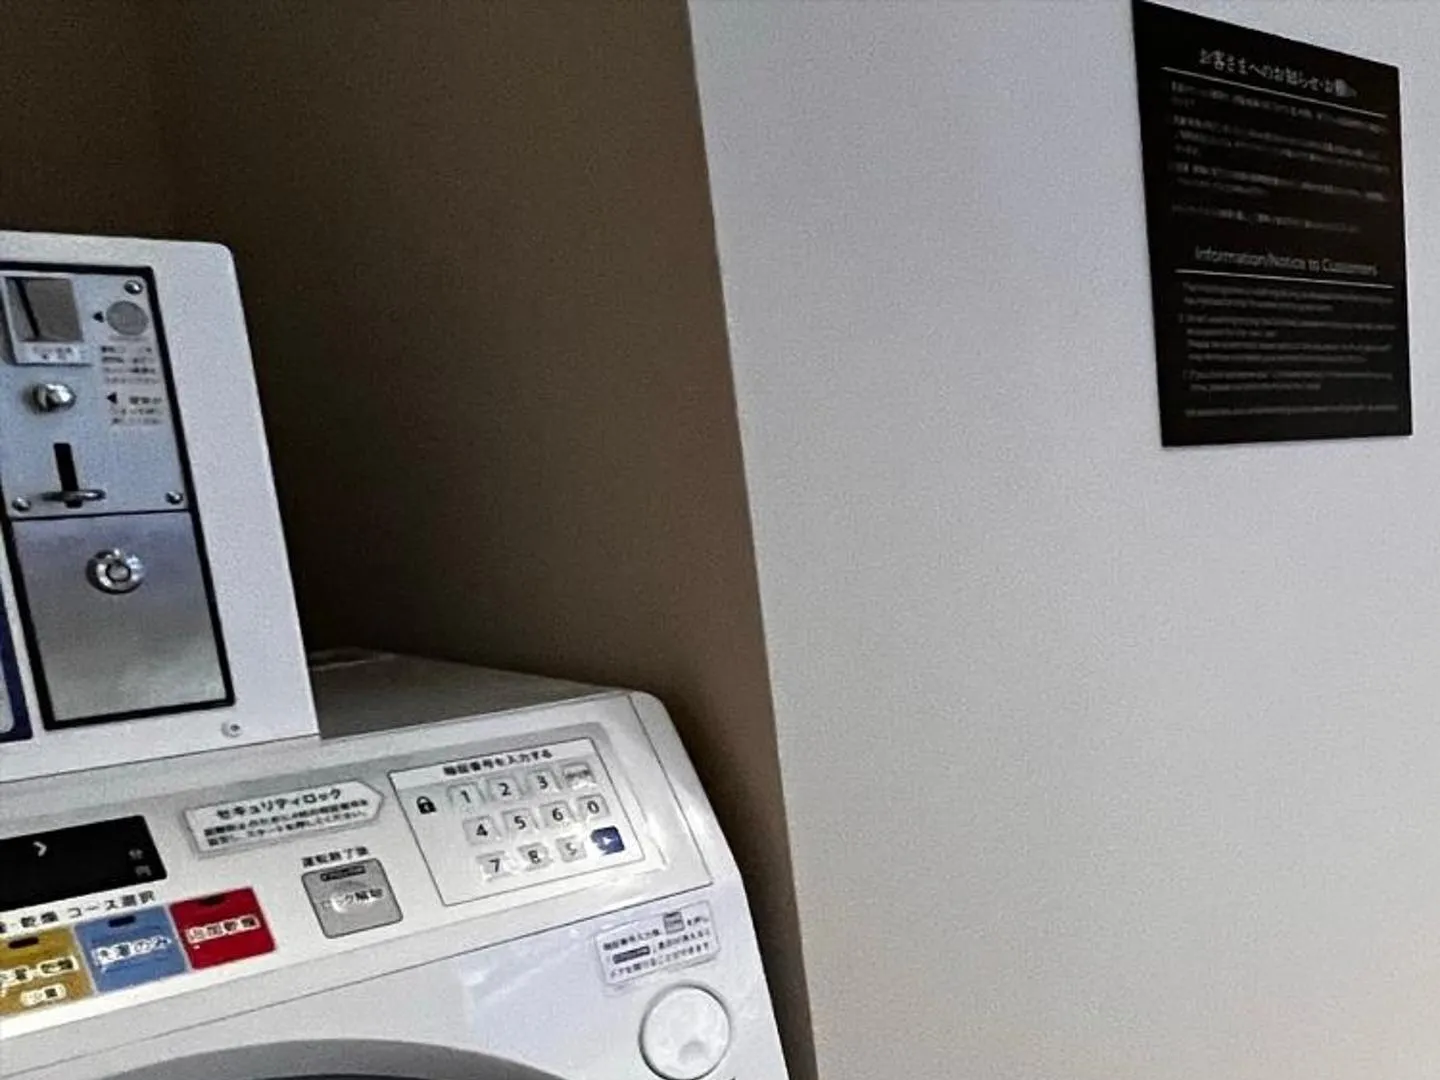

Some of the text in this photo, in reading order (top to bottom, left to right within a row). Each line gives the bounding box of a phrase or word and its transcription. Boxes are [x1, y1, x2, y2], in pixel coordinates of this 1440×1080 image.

[216, 788, 341, 820] セキュリティロック
[460, 776, 548, 803] 1 2 3
[476, 801, 600, 837] 4 5 6 0
[488, 858, 500, 873] 7
